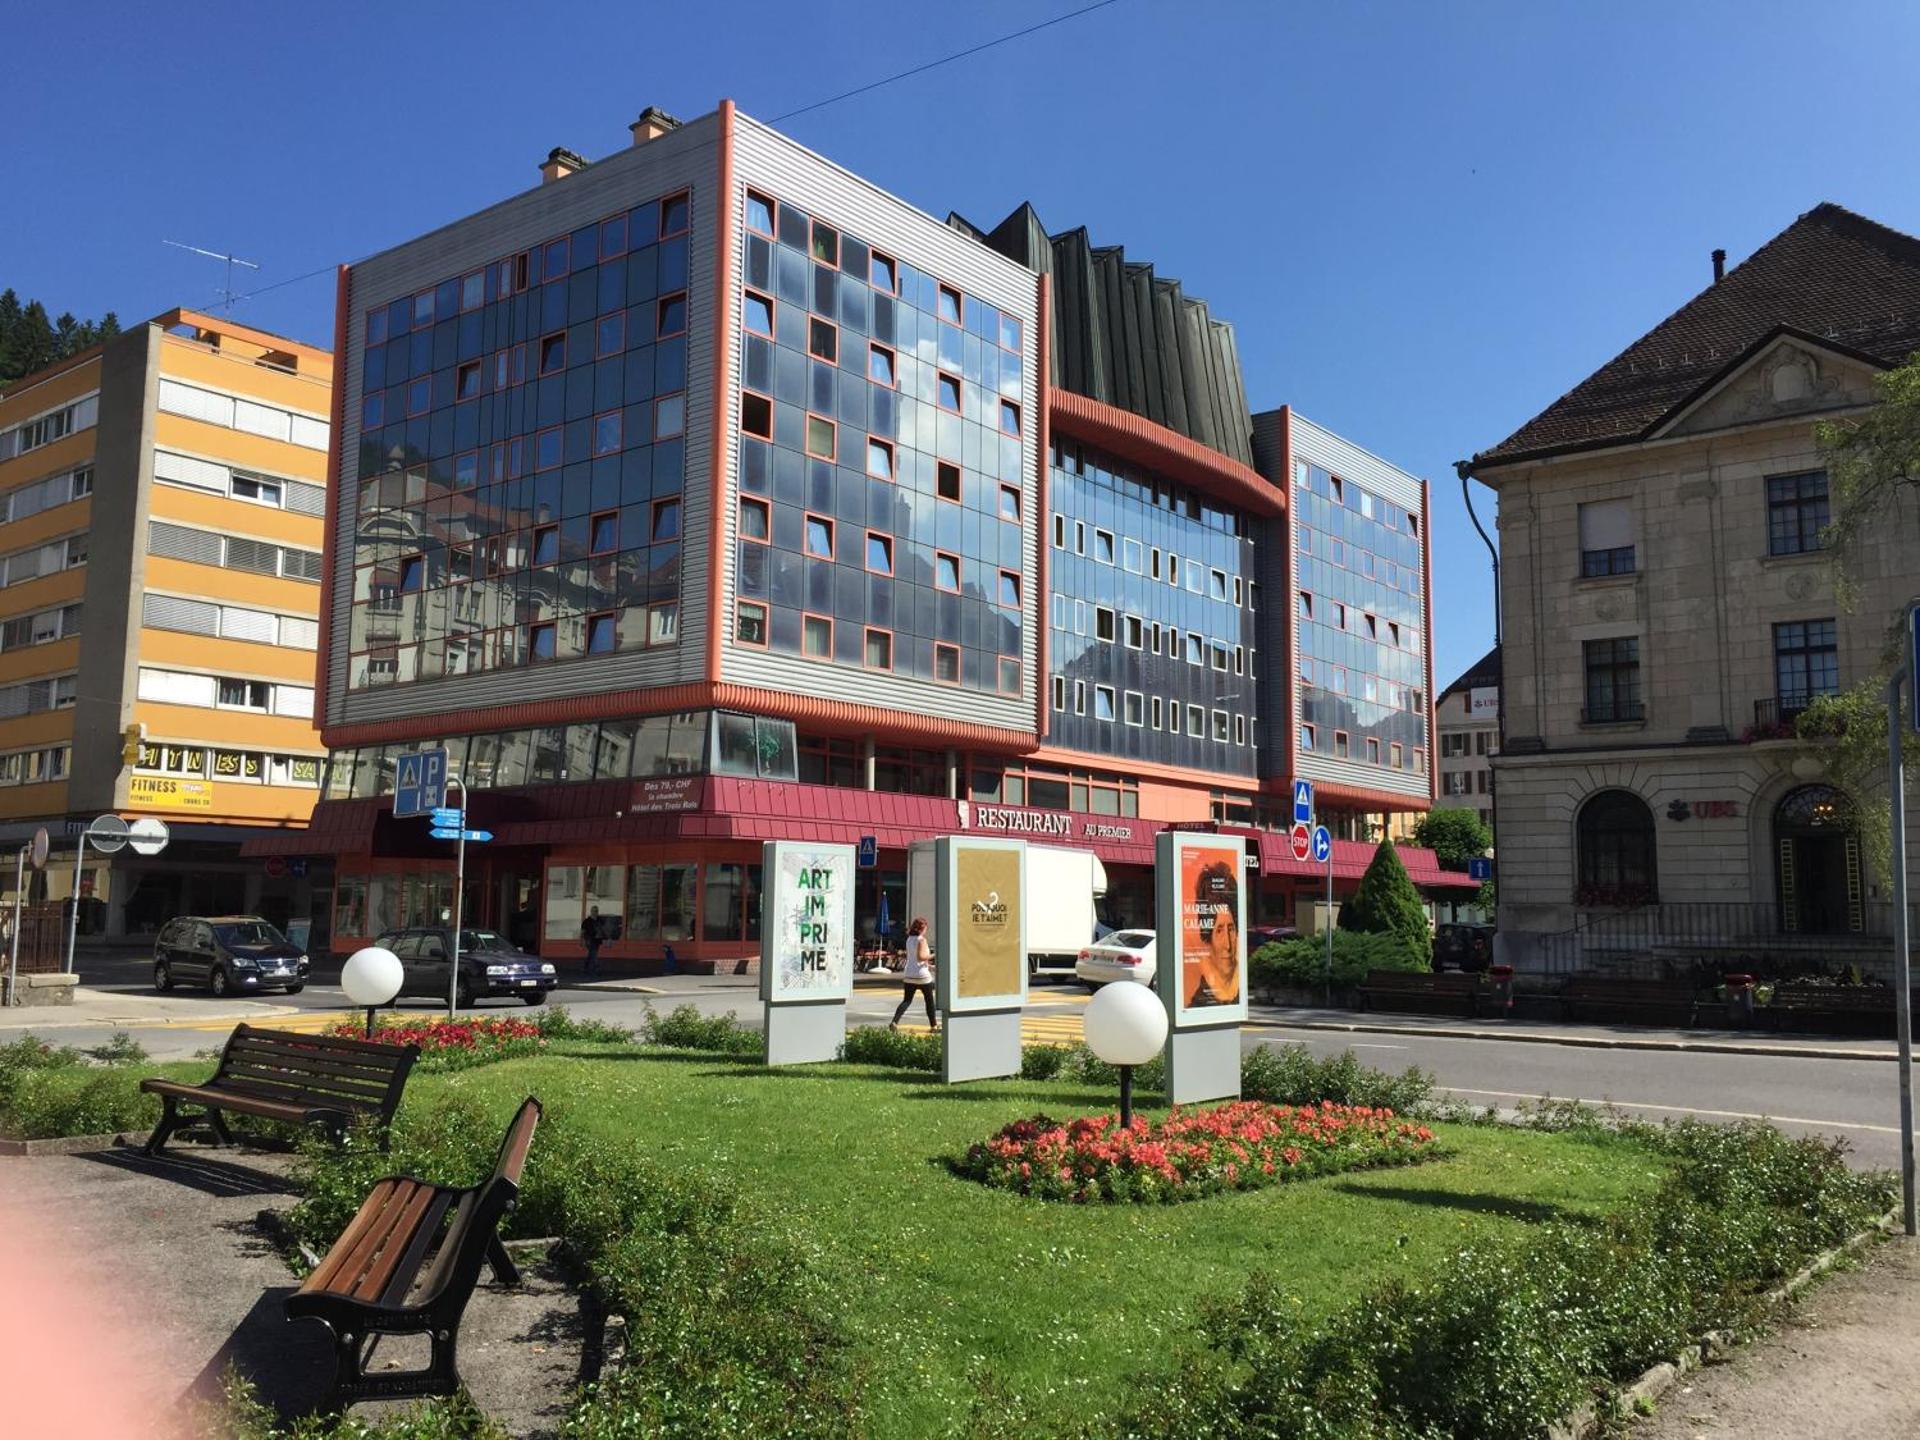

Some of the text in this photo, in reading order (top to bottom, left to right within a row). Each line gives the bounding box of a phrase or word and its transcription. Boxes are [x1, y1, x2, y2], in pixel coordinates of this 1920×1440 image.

[428, 756, 439, 784] P
[131, 779, 176, 793] FITNESS
[1693, 801, 1737, 819] UBS
[977, 806, 1131, 840] RESTAURANT AU PREMIER
[1294, 836, 1308, 848] STOP
[798, 868, 832, 889] ART
[805, 895, 825, 916] IM
[1183, 903, 1229, 914] MARIE-ANNE
[800, 923, 828, 944] PRI
[1183, 918, 1214, 929] CALAME
[801, 946, 826, 971] MÉ
